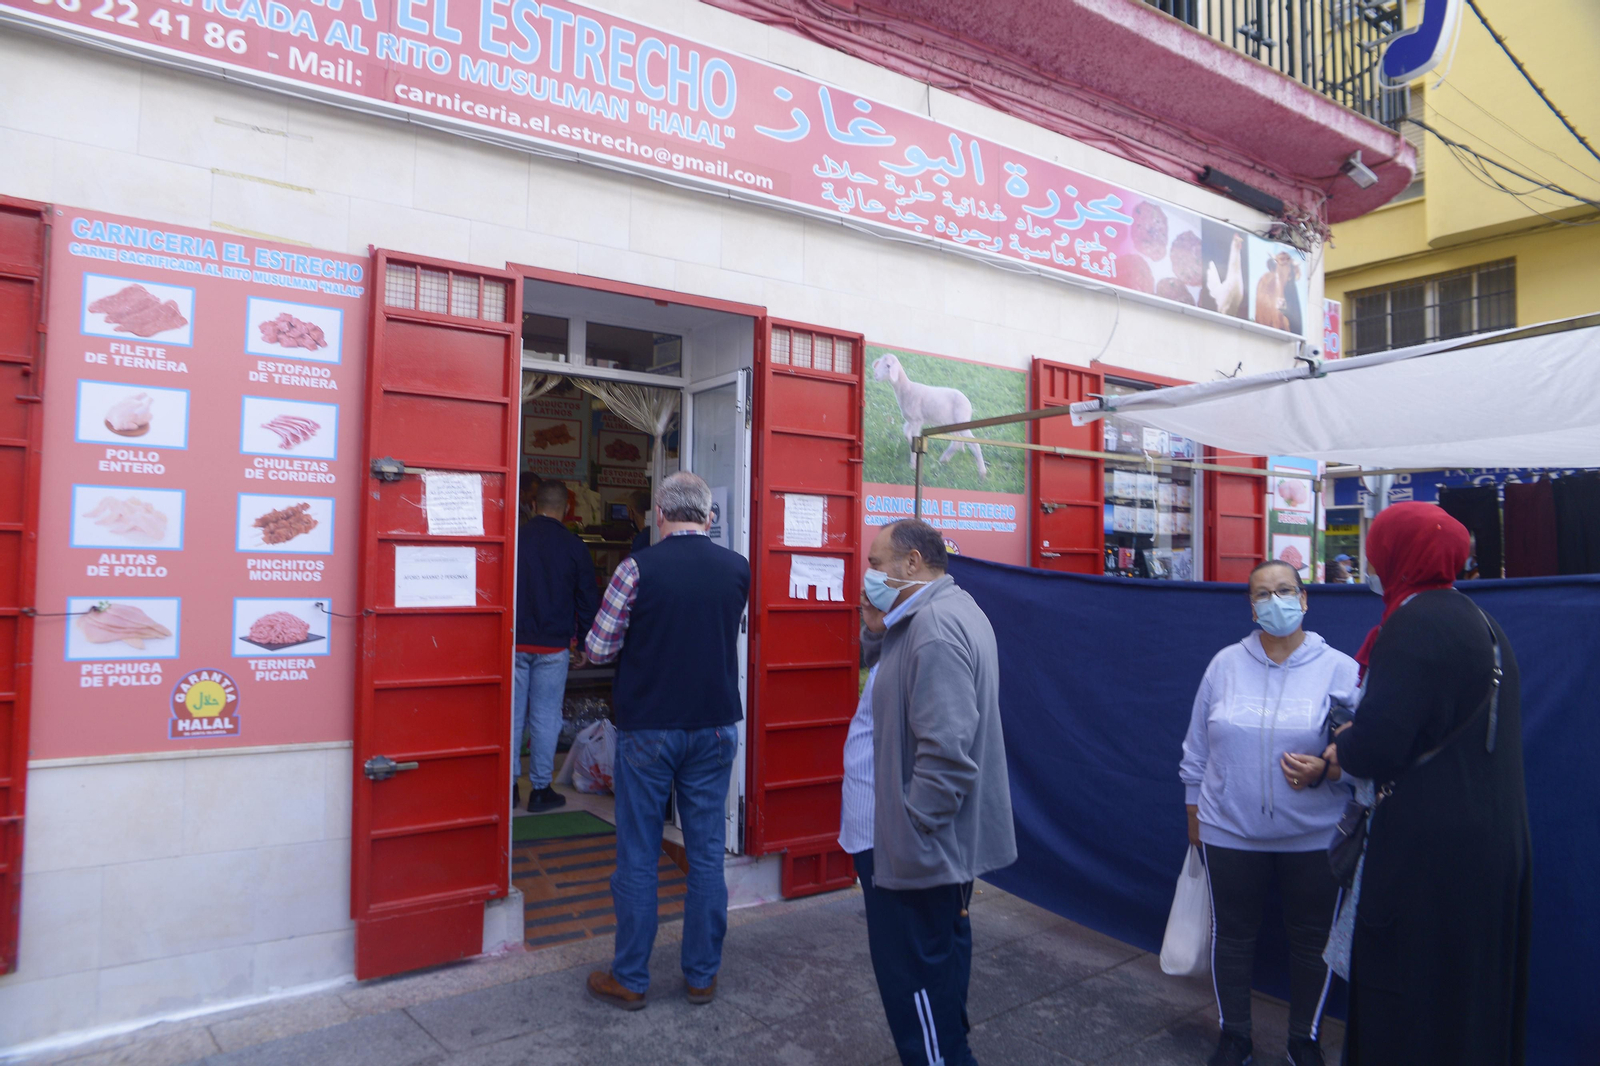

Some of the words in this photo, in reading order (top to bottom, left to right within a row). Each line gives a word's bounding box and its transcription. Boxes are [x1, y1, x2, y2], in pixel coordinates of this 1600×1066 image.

[148, 8, 191, 41] 41
[203, 22, 248, 54] 86
[289, 46, 362, 87] Mail:
[478, 0, 737, 120] ESTRECHO
[324, 18, 370, 56] AL
[375, 31, 452, 75] RITO
[459, 54, 629, 124] MUSULMAN
[635, 101, 736, 149] "HALAL"
[394, 81, 774, 190] carniceria.el.estrecho@gmail.com
[813, 154, 879, 185] حلال
[821, 182, 886, 213] عالية
[885, 174, 936, 205] طرية
[1005, 162, 1134, 237] مجزرة
[887, 206, 929, 232] جد
[1015, 215, 1051, 238] مواد
[72, 217, 218, 260] CARNICERIA
[223, 244, 250, 265] EL
[255, 248, 364, 282] ESTRECHO
[1009, 234, 1076, 266] مناسبة
[69, 242, 117, 261] CARNE
[119, 250, 202, 274] SACRIFICADA
[204, 263, 222, 277] AL
[223, 266, 251, 281] RITO
[253, 272, 318, 292] MUSULMAN
[110, 342, 166, 359] FILETE
[85, 352, 107, 364] DE
[112, 355, 188, 373] TERNERA
[257, 361, 331, 378] ESTOFADO
[249, 371, 269, 383] DE
[272, 373, 338, 390] TERNERA
[534, 408, 573, 417] LATINOS
[105, 449, 160, 462] POLLO
[527, 458, 577, 468] PINCHITOS
[99, 460, 166, 475] ENTERO
[254, 457, 329, 473] CHULETAS
[244, 468, 266, 480] DE
[268, 470, 336, 484] CORDERO
[603, 469, 644, 479] ESTOFADO
[613, 478, 648, 486] TERNERA
[942, 500, 957, 517] EL
[958, 501, 1016, 520] ESTRECHO
[98, 554, 158, 566] ALITAS
[247, 559, 325, 571] PINCHITOS
[87, 565, 110, 577] DE
[114, 566, 168, 578] POLLO
[250, 570, 322, 582] MORUNOS
[81, 663, 163, 675] PECHUGA
[248, 659, 316, 670] TERNERA
[80, 675, 104, 687] DE
[108, 674, 162, 687] POLLO
[255, 670, 309, 681] PICADA
[175, 671, 237, 703] GARANTIA
[178, 717, 234, 731] HALAL
